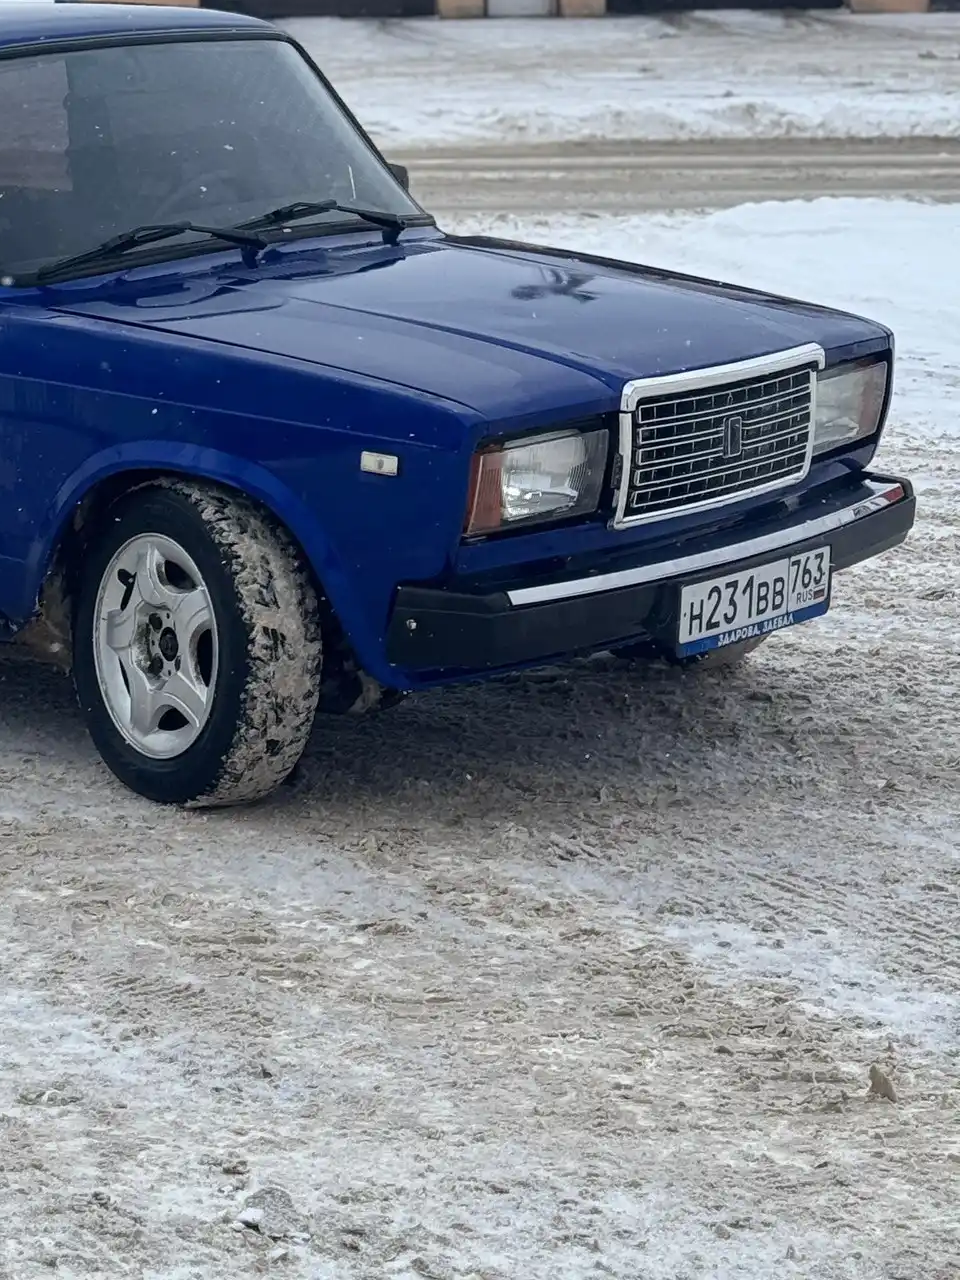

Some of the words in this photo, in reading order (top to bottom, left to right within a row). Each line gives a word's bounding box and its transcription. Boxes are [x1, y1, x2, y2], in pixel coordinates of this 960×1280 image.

[689, 575, 785, 636] Н231ВВ
[791, 552, 825, 593] 763
[796, 591, 813, 603] RUS
